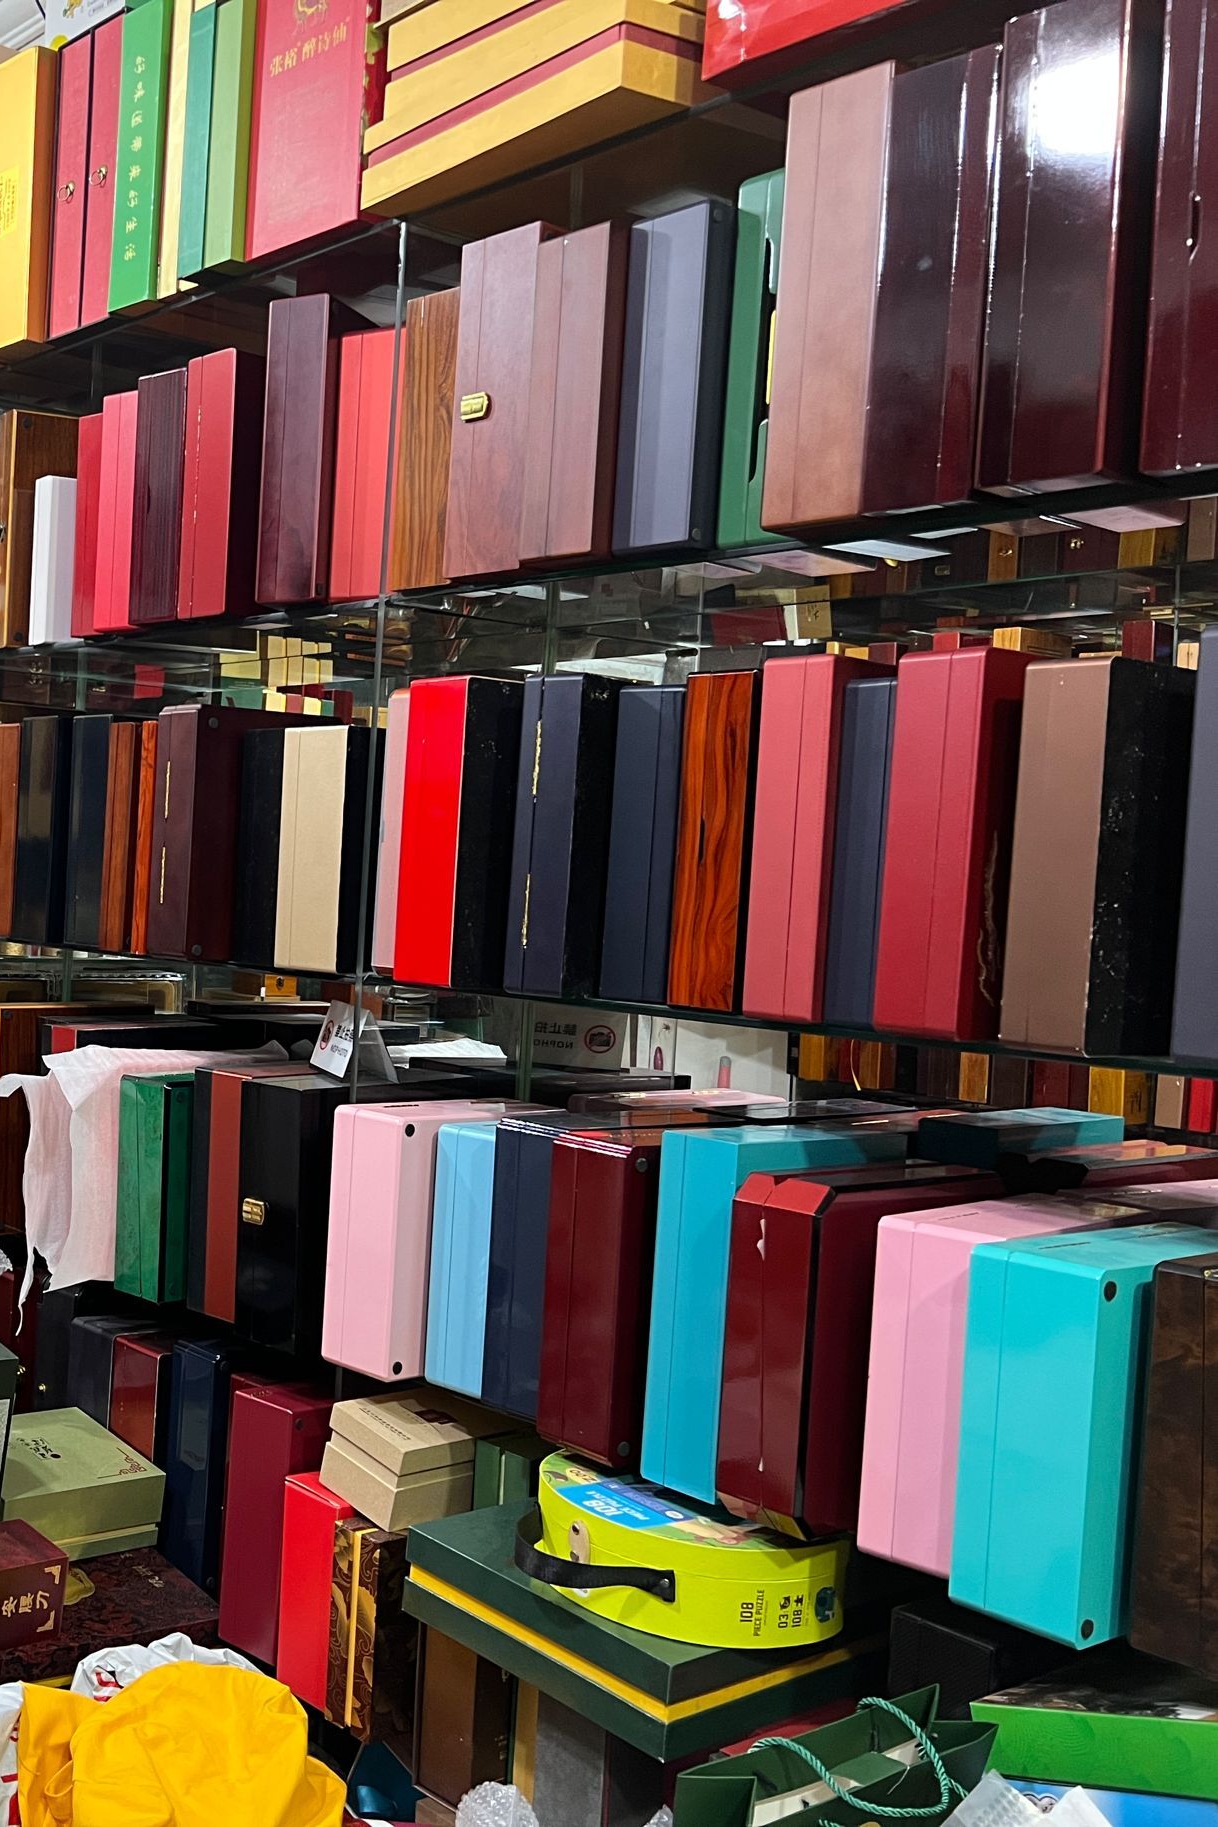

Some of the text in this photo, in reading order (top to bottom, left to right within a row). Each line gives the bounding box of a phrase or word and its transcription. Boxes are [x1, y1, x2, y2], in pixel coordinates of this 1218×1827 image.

[739, 1602, 755, 1623] 108
[752, 1589, 765, 1637] PIECE PUZZLE
[777, 1614, 789, 1629] 03
[791, 1609, 803, 1628] 108
